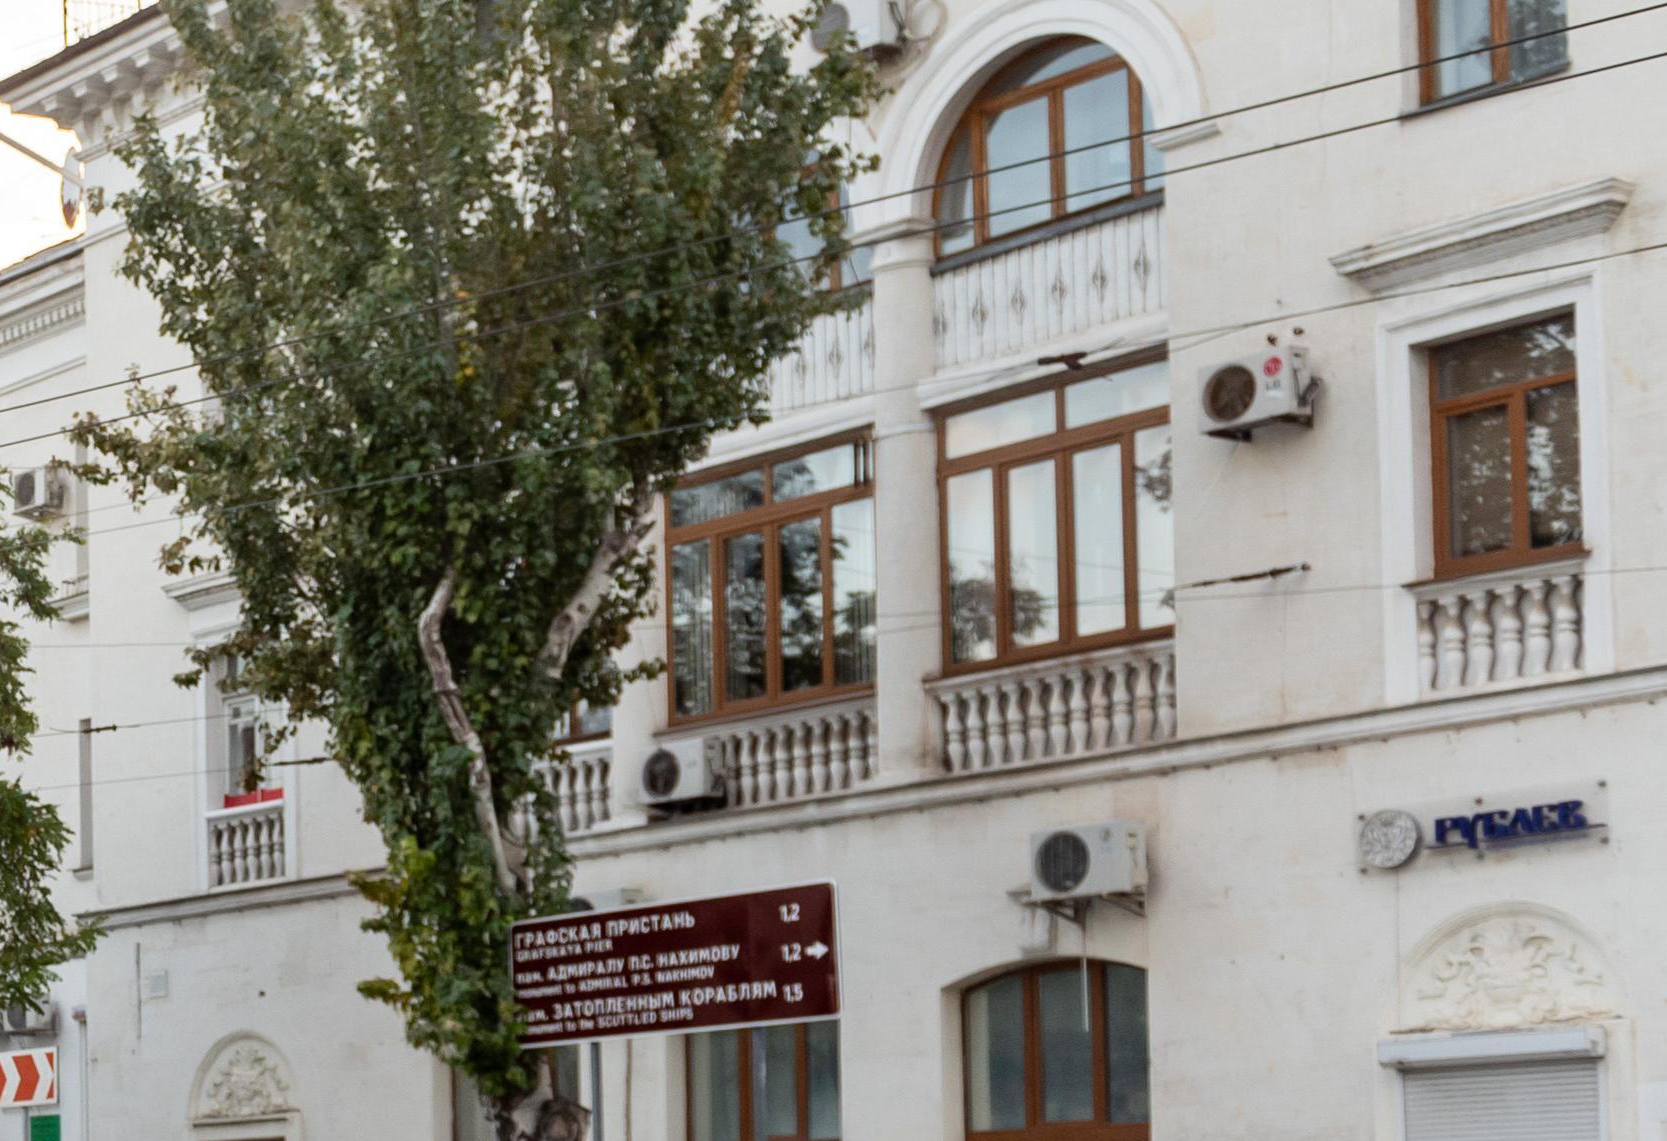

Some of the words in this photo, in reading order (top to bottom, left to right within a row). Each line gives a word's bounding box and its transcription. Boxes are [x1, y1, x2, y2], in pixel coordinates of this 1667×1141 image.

[514, 922, 602, 949] ГРАФСКАЯ
[606, 911, 696, 938] ПРИСТАНЬ
[584, 939, 613, 953] PIER
[516, 971, 544, 985] пам.
[547, 958, 625, 981] АДМИРАЛУ
[628, 954, 654, 971] П.С.
[656, 943, 740, 968] НАХИМОВУ
[564, 983, 576, 994] to
[578, 976, 628, 992] ADMIRAL
[655, 965, 714, 984] NAKHIMOV
[552, 991, 674, 1020] ЗАТОПЛЕННЫМ
[679, 980, 777, 1006] КОРАБЛЯМ
[564, 1021, 577, 1033] to
[597, 1010, 657, 1029] SCUTTLED
[658, 1007, 694, 1023] SHIPS
